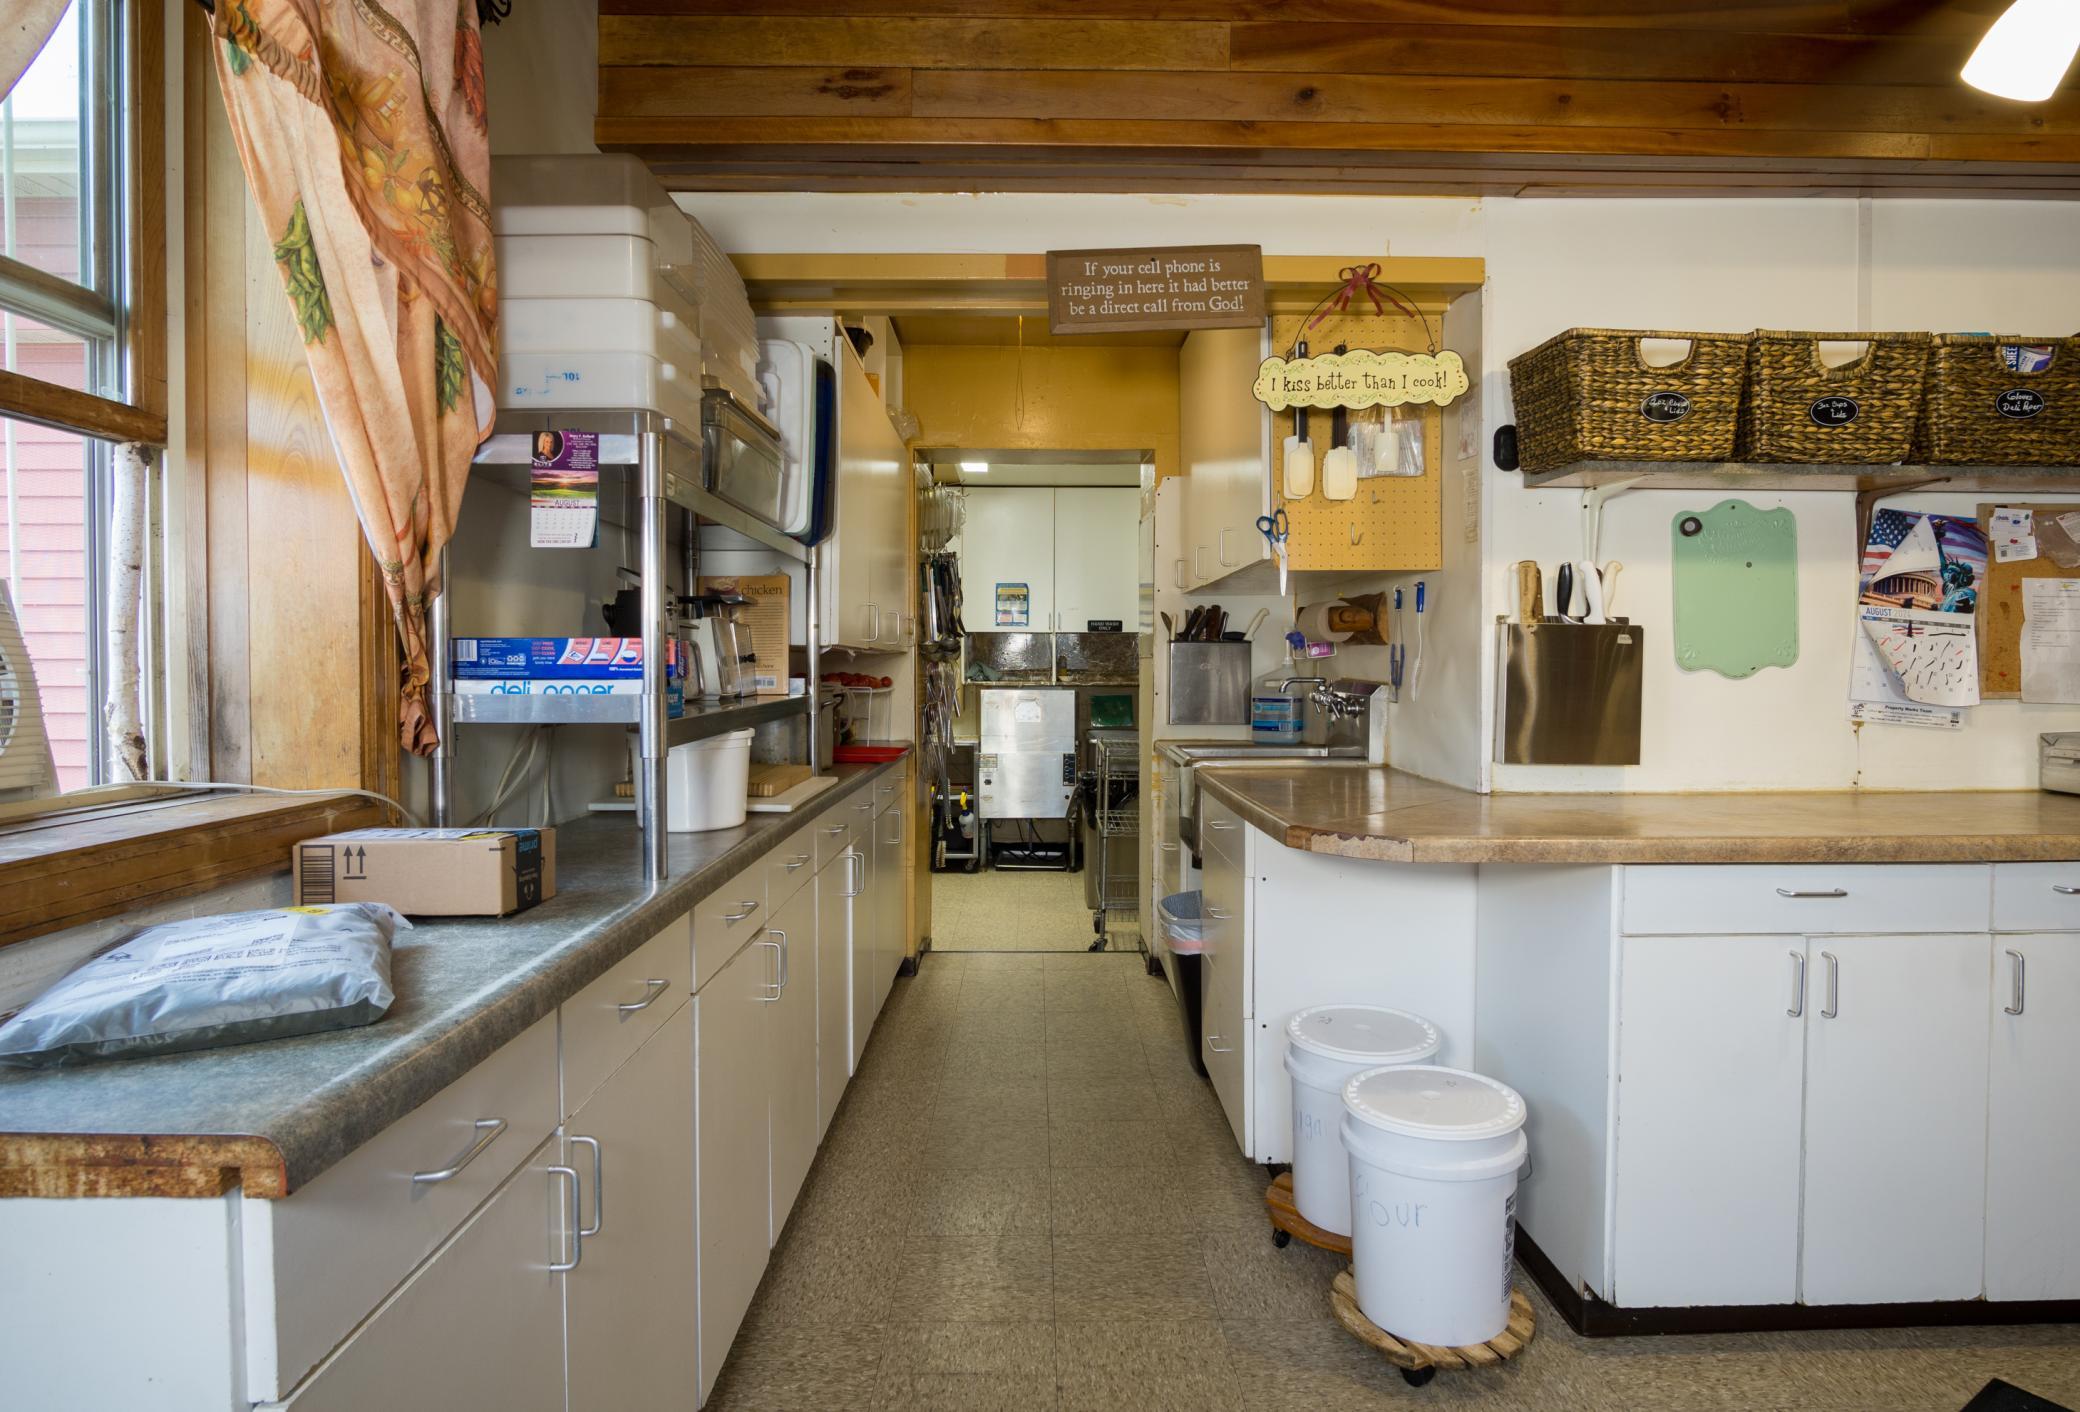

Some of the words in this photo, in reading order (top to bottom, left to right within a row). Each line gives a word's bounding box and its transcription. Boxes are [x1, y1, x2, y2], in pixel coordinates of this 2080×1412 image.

[1084, 261, 1098, 276] If
[1102, 263, 1134, 278] your
[1138, 260, 1161, 274] cell
[1165, 259, 1205, 278] phone
[1209, 259, 1221, 273] is
[1061, 282, 1114, 300] ringing
[1118, 280, 1133, 295] in
[1137, 280, 1165, 294] here
[1168, 279, 1180, 293] it
[1183, 278, 1208, 292] had
[1211, 277, 1250, 292] better
[1069, 302, 1085, 315] be
[1088, 305, 1096, 315] a
[1099, 300, 1139, 314] direct
[1143, 299, 1168, 313] call
[1171, 299, 1206, 312] from
[1209, 295, 1244, 312] God!
[1271, 377, 1277, 391] I
[1283, 375, 1311, 392] kiss
[1317, 372, 1358, 391] better
[1362, 371, 1396, 389] than
[1402, 374, 1407, 389] I
[1413, 370, 1448, 388] cook!
[2006, 392, 2033, 401] Gloves
[2002, 402, 2021, 411] Deli
[741, 584, 783, 596] chicken
[1865, 607, 1893, 617] AUGUST
